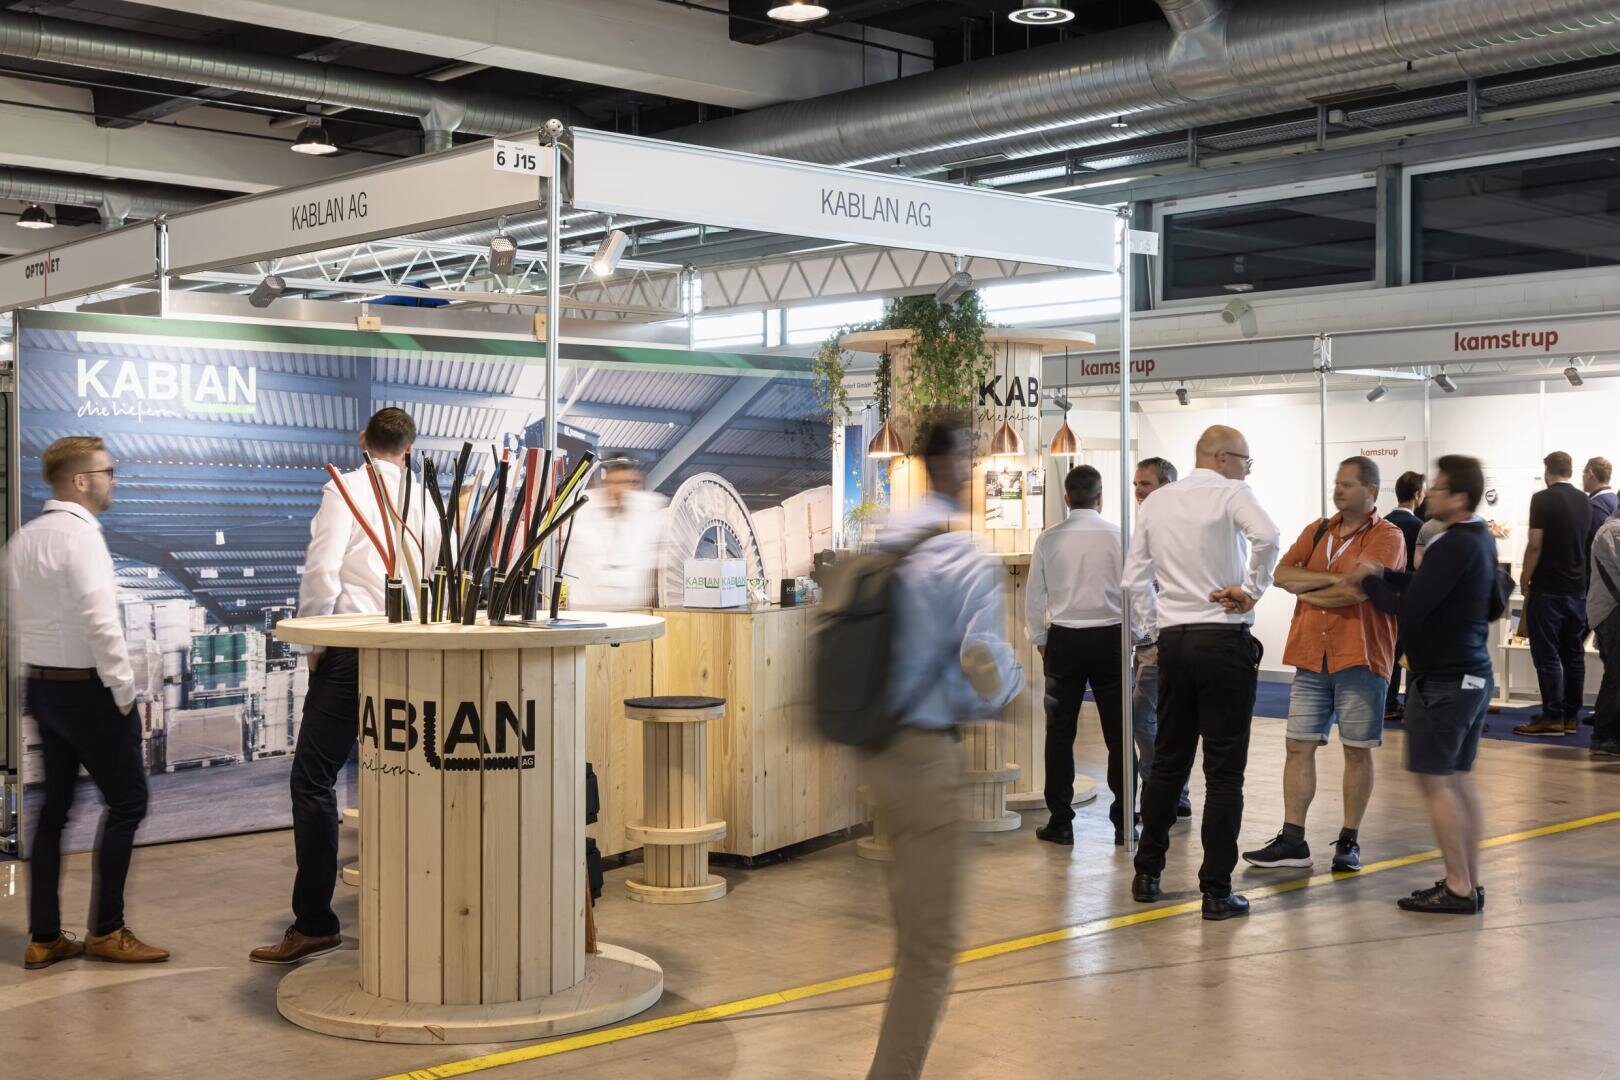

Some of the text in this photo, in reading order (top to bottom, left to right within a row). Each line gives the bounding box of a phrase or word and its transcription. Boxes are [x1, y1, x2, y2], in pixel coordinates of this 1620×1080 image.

[496, 150, 536, 170] 6 J15
[292, 191, 368, 231] KABLAN AG
[821, 188, 931, 228] KABLAN AG
[25, 257, 60, 279] OPTONET
[1454, 329, 1559, 352] kamstrup
[1081, 359, 1155, 377] kamsrup
[77, 358, 257, 414] KABLAN
[1360, 448, 1399, 457] kamstrup
[685, 577, 720, 589] KABLAN
[721, 576, 746, 588] KABLAN
[357, 693, 536, 770] ABLAN
[521, 757, 535, 767] AG
